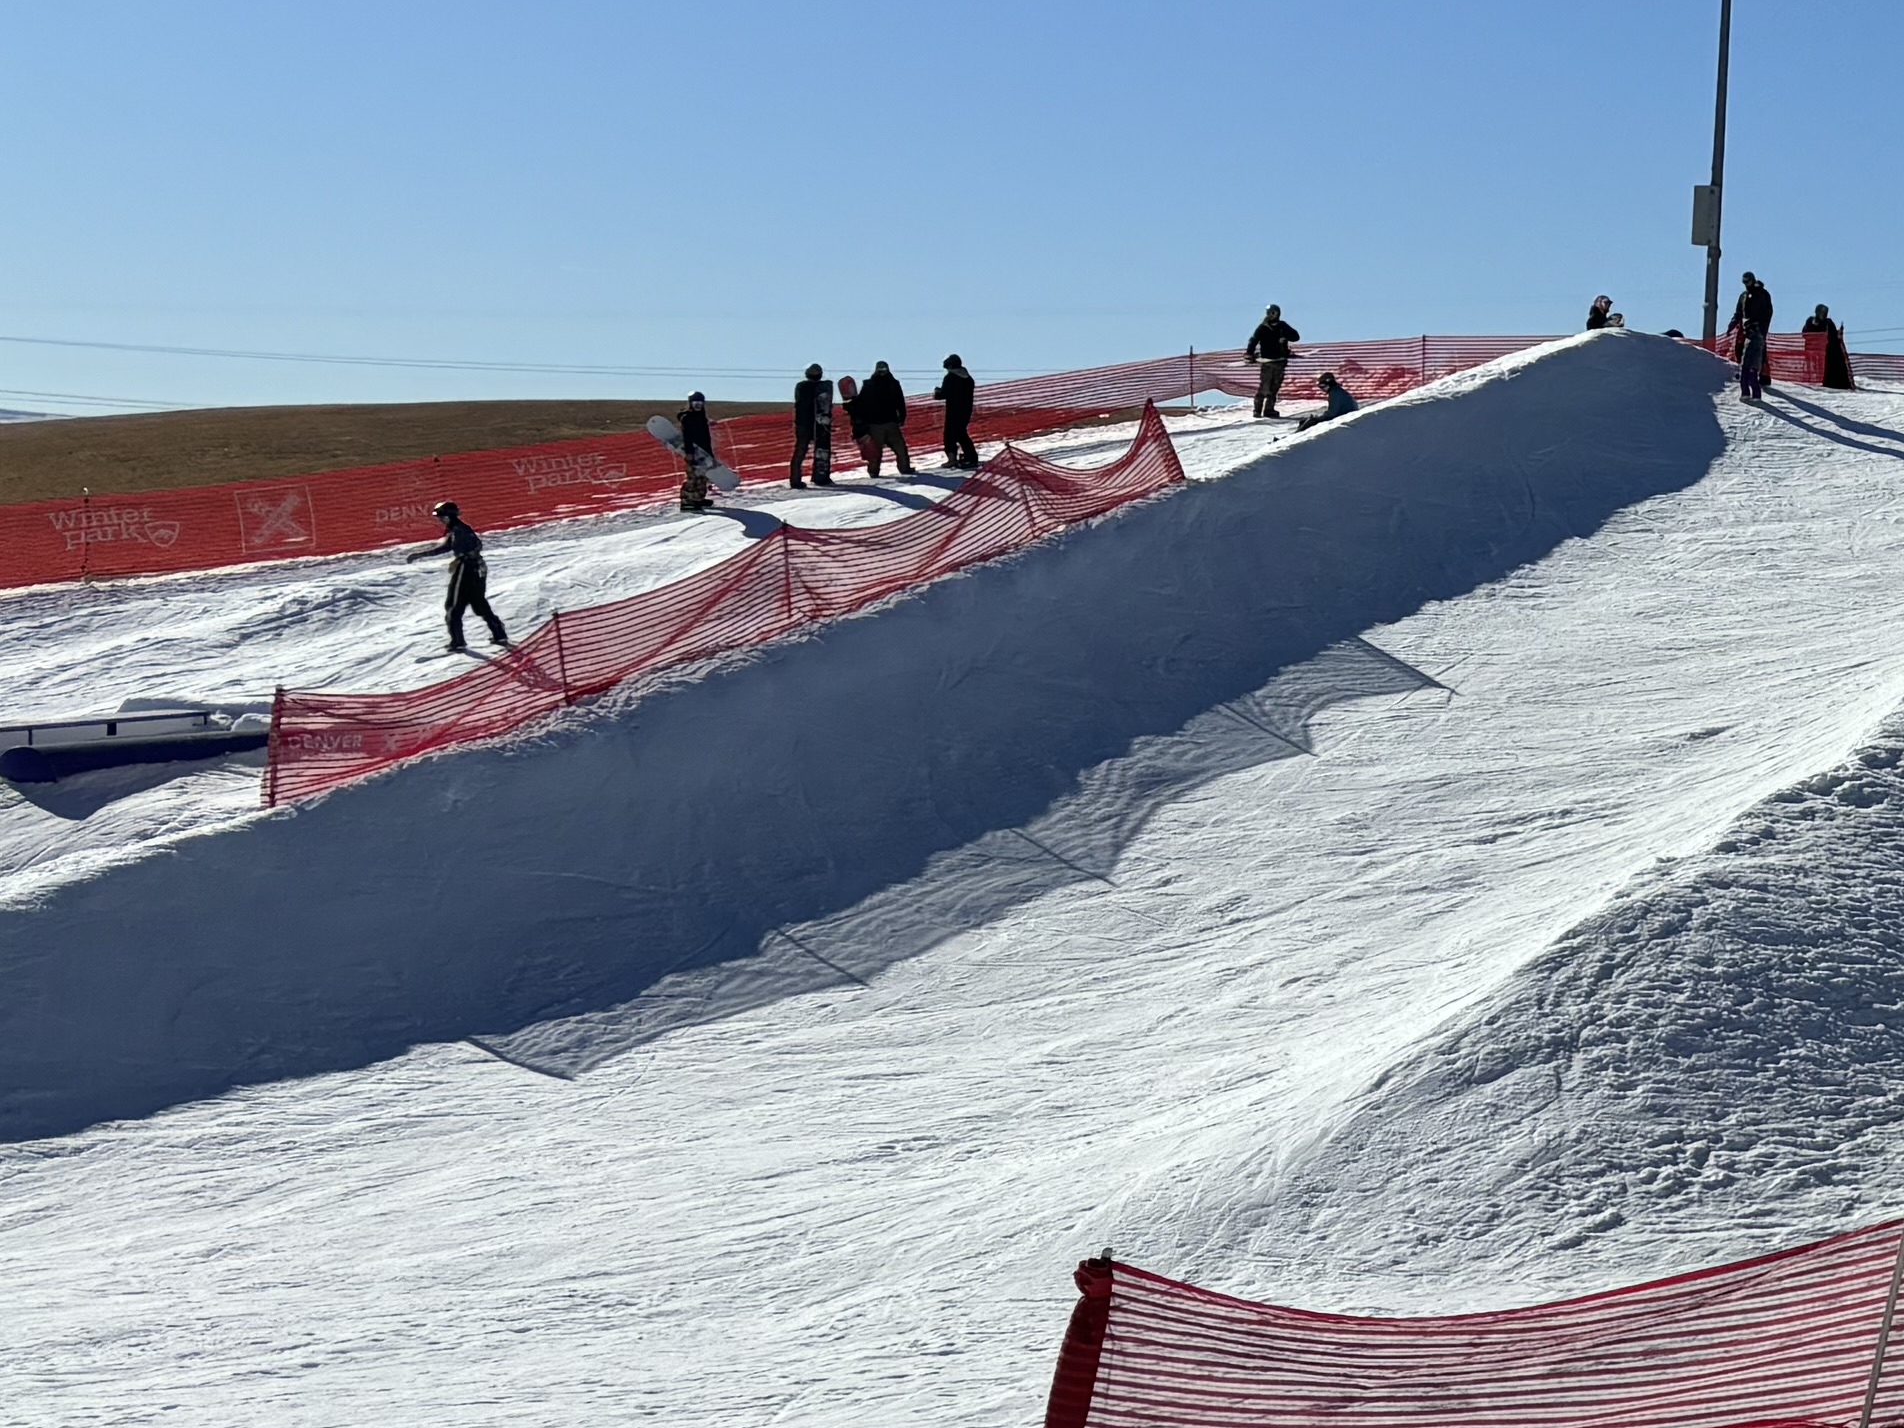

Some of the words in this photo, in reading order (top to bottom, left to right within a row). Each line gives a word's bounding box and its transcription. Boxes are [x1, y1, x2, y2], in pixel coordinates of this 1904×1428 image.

[513, 452, 608, 477] Winter
[48, 506, 153, 531] Winter
[374, 503, 432, 523] DENV
[61, 521, 150, 552] park
[287, 733, 364, 751] DENVER
